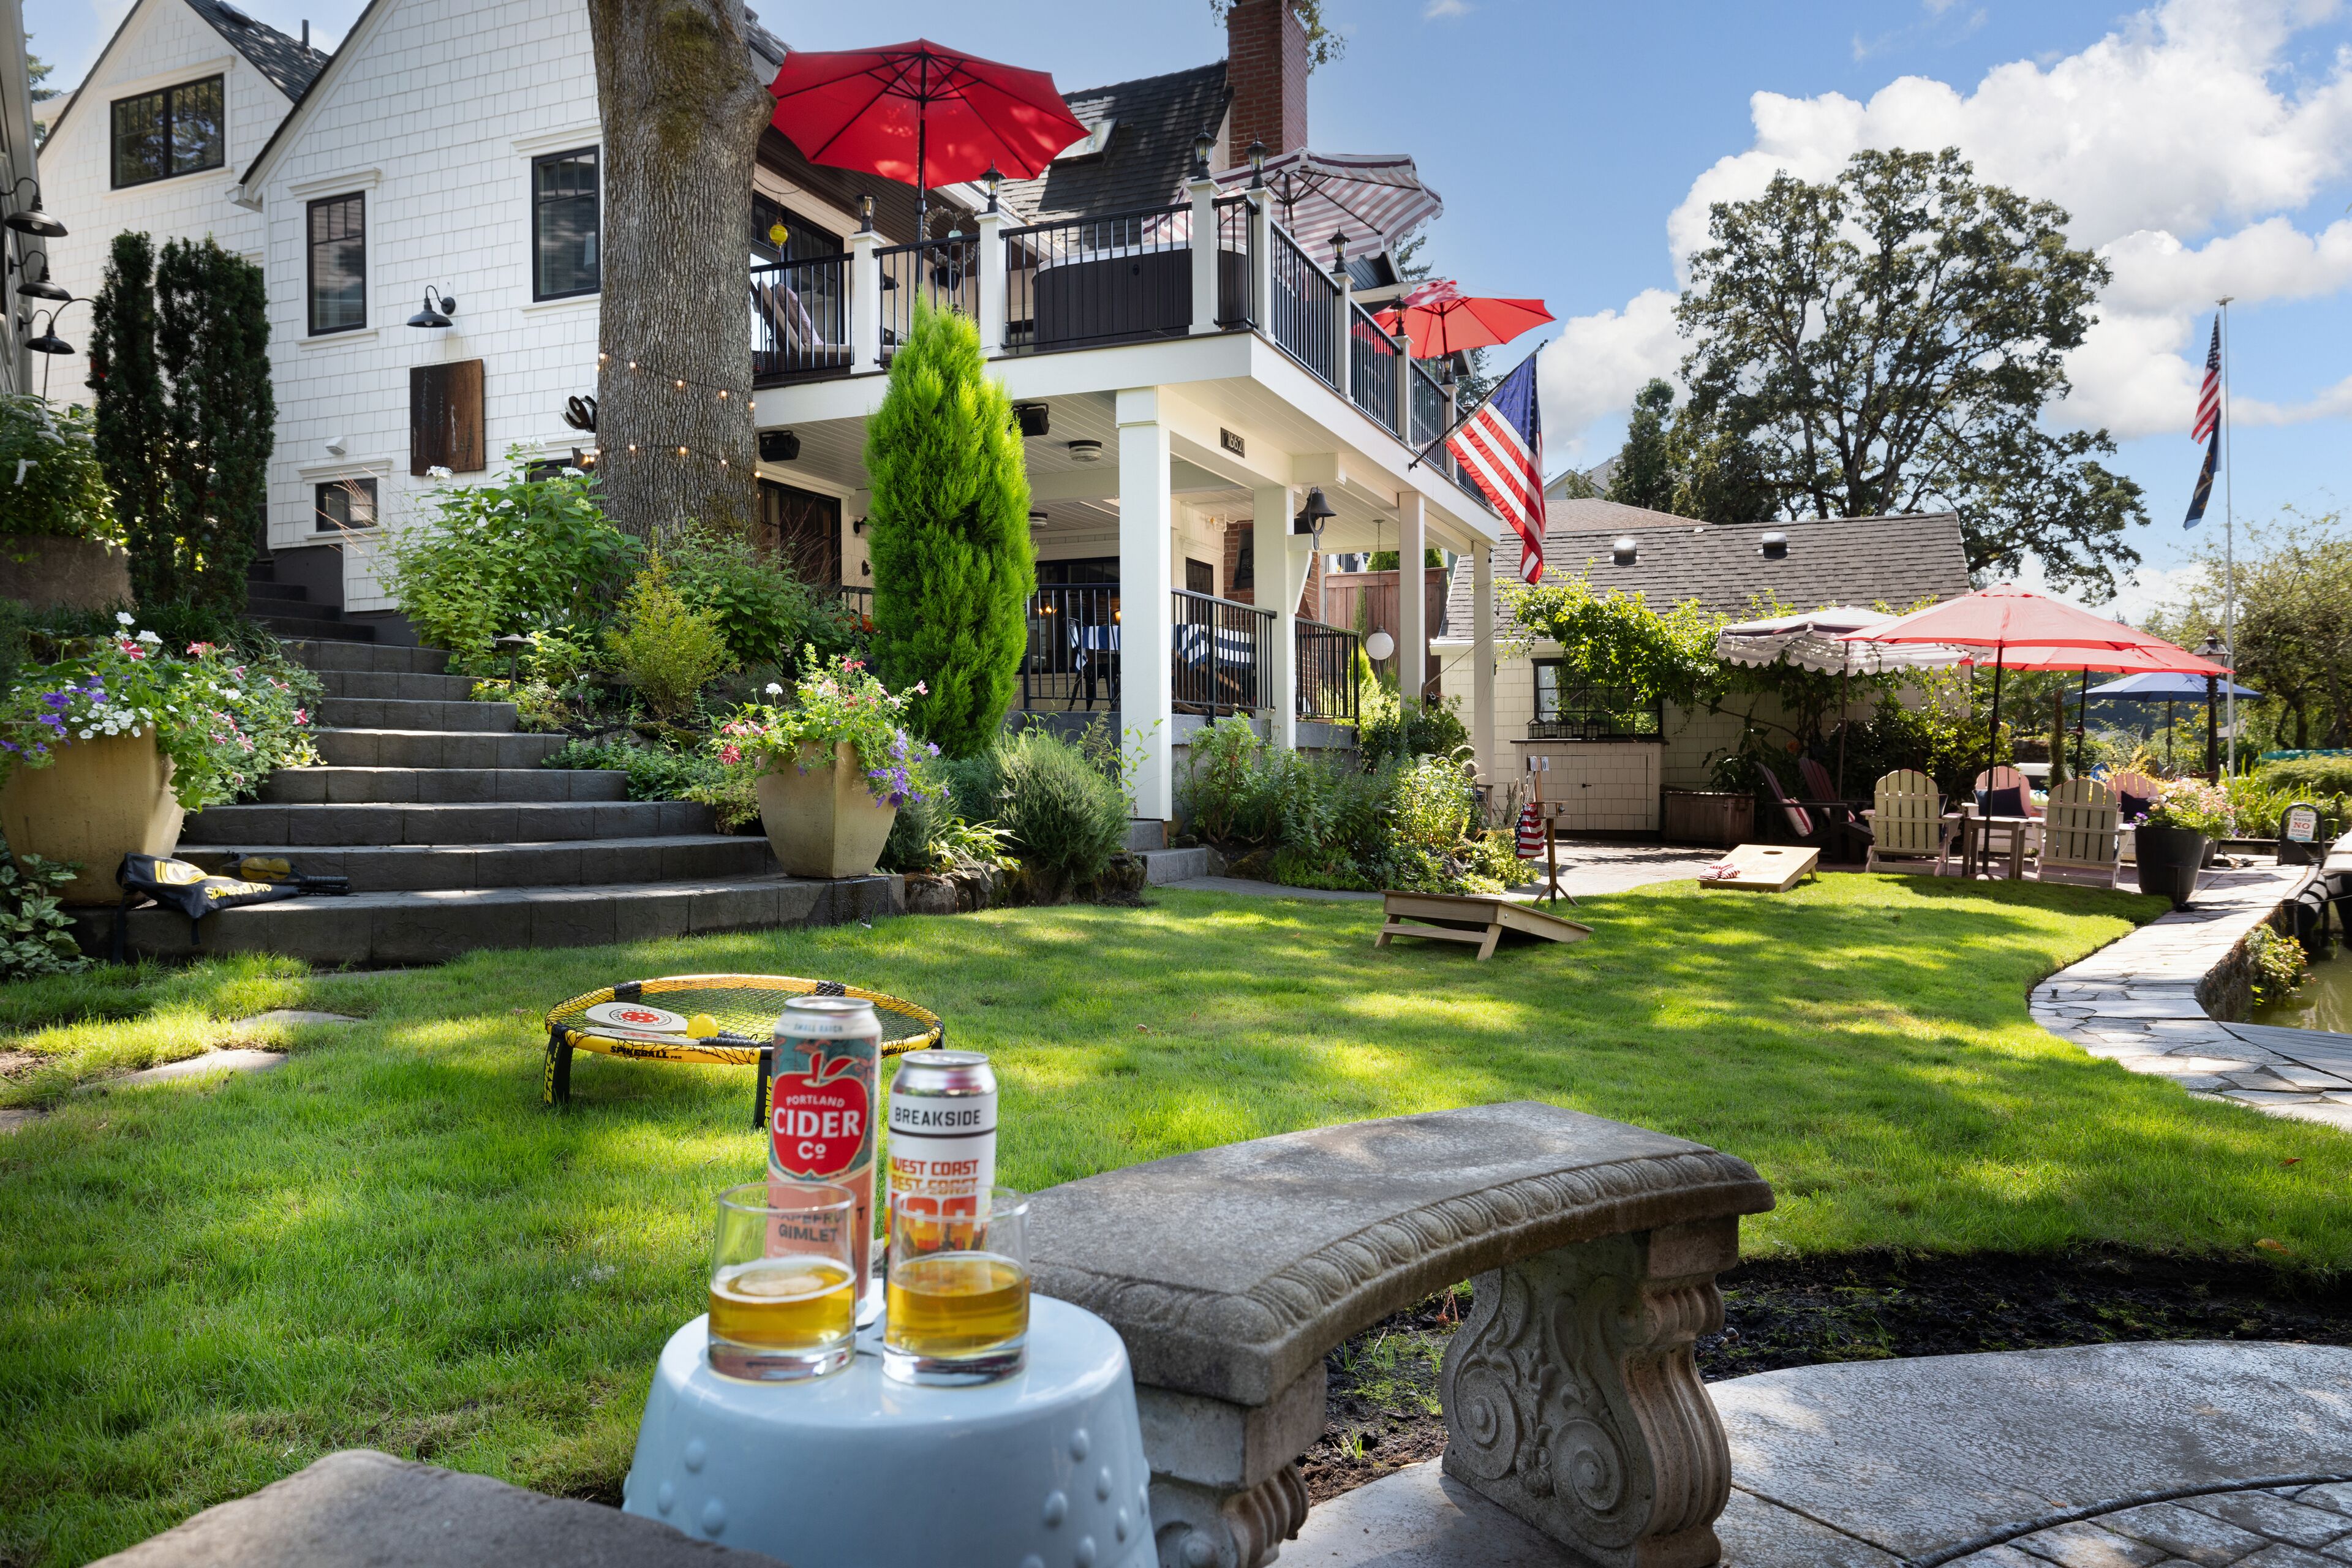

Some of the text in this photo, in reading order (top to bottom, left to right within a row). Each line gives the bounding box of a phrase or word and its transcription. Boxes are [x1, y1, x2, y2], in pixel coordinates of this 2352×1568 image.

[1227, 432, 1244, 454] 16621
[610, 1046, 669, 1058] SPIKEBALL
[786, 1095, 845, 1108] PORTLAND
[774, 1107, 861, 1138] CIDER
[895, 1107, 981, 1126] BREAKSIDE
[892, 1156, 979, 1175] WEST COAST
[779, 1224, 838, 1242] GIMLET
